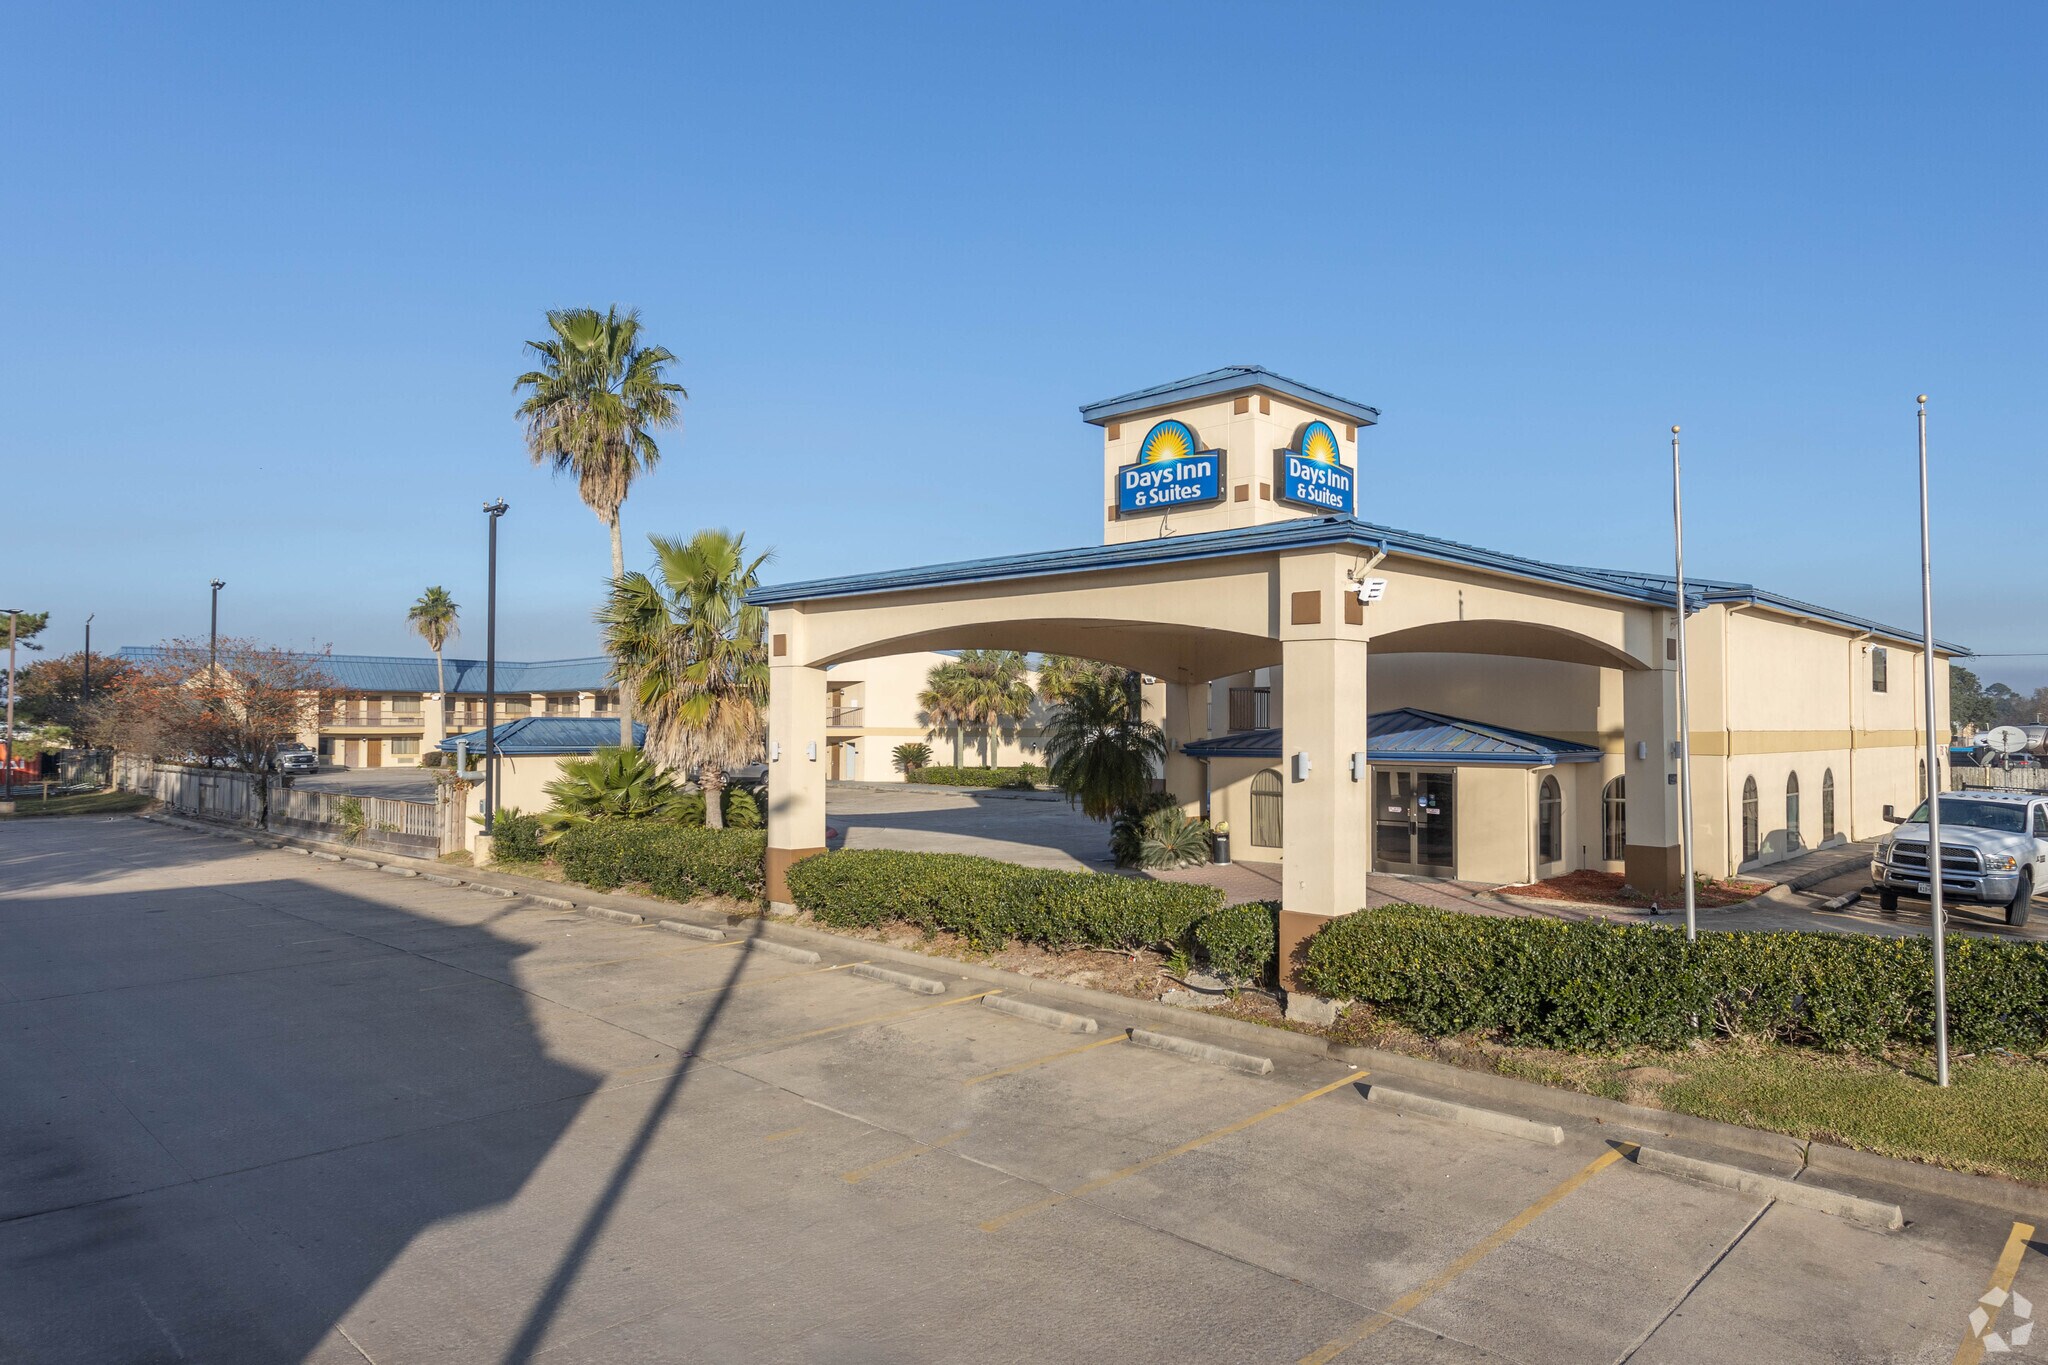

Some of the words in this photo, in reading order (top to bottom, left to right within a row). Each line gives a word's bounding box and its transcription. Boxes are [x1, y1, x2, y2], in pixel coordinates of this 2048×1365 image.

[1126, 467, 1174, 489] Days
[1176, 461, 1211, 481] Inn
[1290, 458, 1326, 485] Days
[1327, 468, 1349, 491] Inn
[1135, 491, 1148, 506] &
[1149, 484, 1201, 504] Suites
[1297, 484, 1307, 499] &
[1308, 484, 1343, 508] Suites
